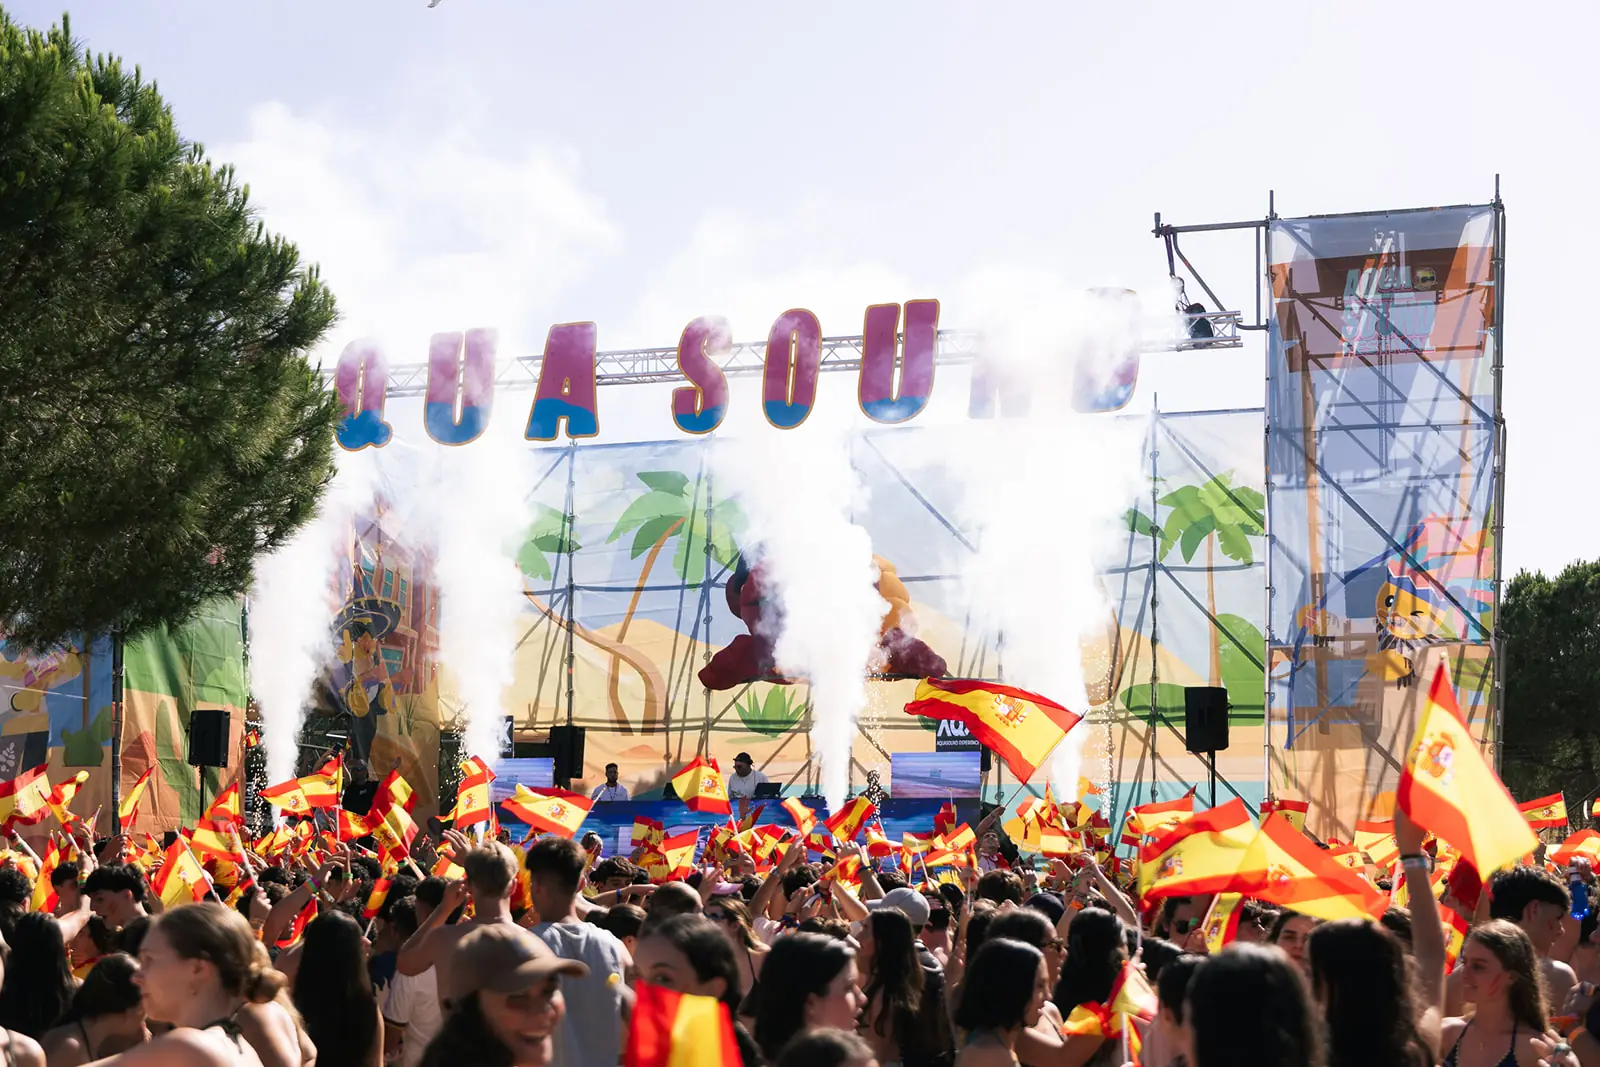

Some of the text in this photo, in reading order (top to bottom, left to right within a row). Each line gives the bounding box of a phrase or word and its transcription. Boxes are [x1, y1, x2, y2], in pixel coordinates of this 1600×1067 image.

[1343, 265, 1412, 299] AQUA
[1341, 301, 1437, 339] SOUND
[937, 719, 970, 737] AQ
